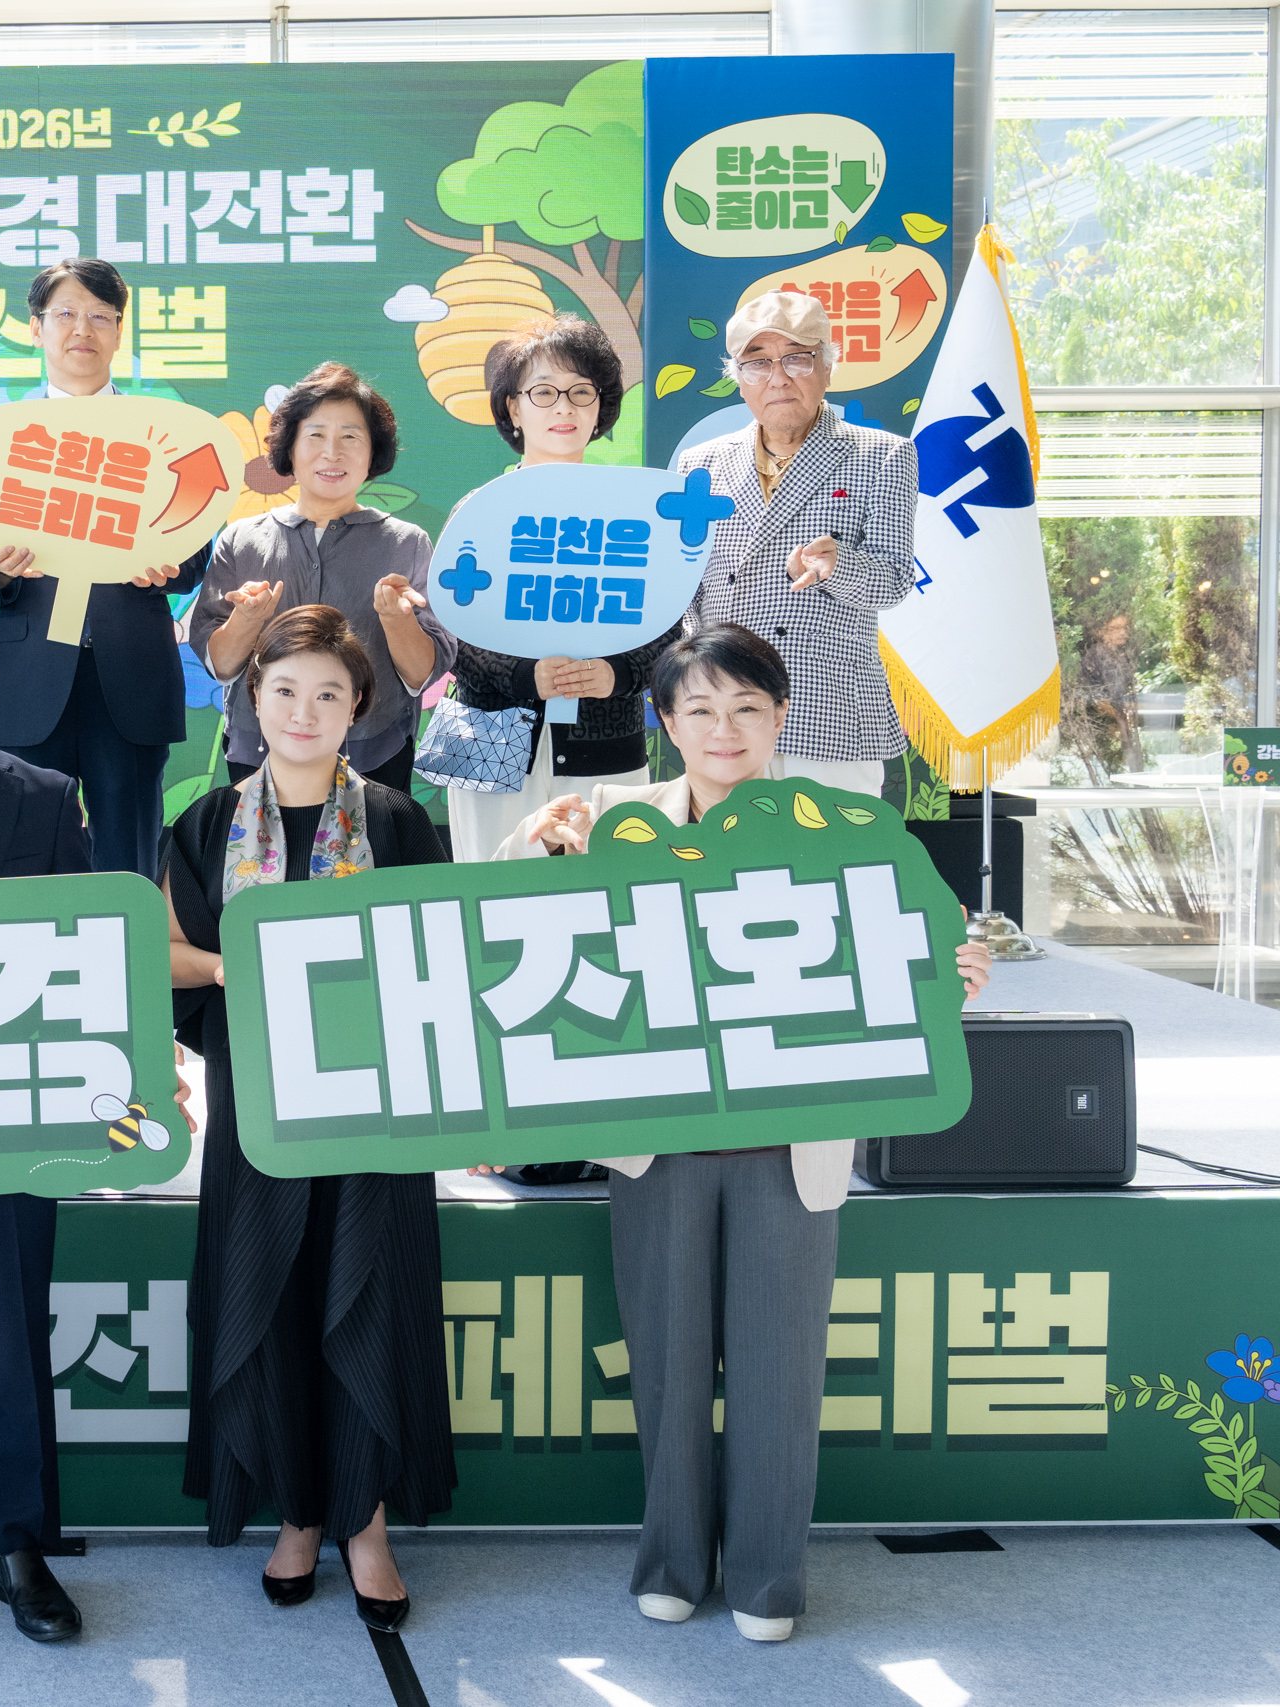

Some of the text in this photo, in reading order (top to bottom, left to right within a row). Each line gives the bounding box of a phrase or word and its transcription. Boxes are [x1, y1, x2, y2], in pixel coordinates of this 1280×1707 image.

[716, 145, 829, 186] 탄소는
[95, 168, 385, 265] 대전환
[716, 190, 829, 230] 줄이고
[7, 423, 151, 494] 순환은
[510, 516, 651, 567] 실천은
[505, 574, 646, 625] 더하고
[258, 864, 930, 1121] 대전환
[1077, 1094, 1087, 1110] JBL
[442, 1271, 1109, 1437] 페티벌
